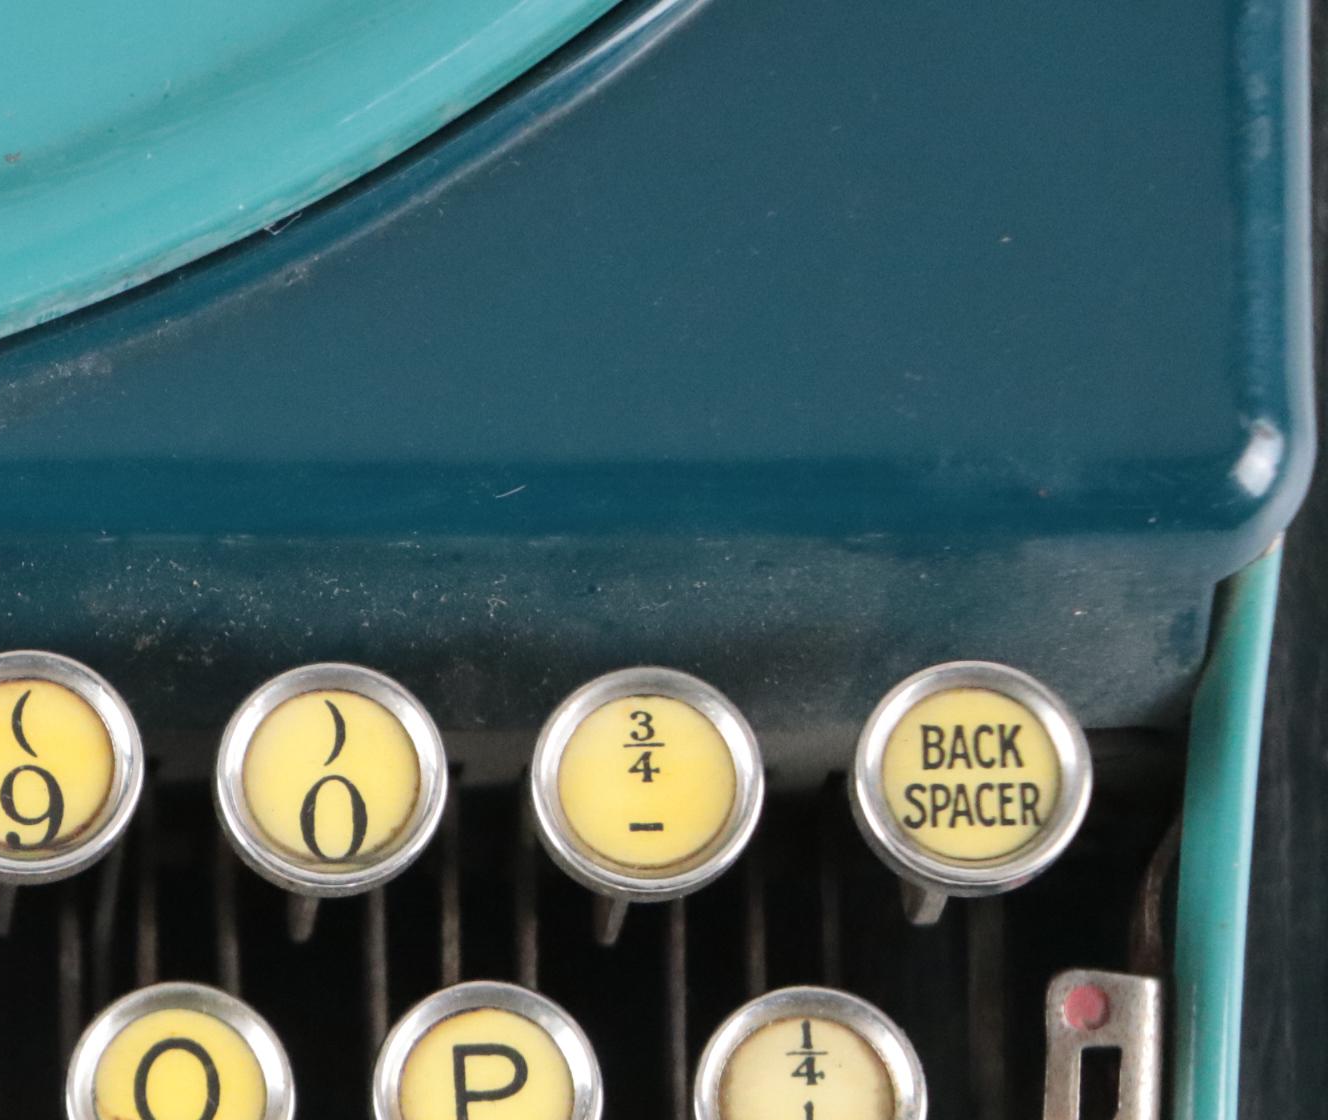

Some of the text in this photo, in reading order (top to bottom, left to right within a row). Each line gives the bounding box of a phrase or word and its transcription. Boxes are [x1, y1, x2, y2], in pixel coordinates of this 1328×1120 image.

[11, 689, 38, 758] (
[324, 699, 346, 766] )
[921, 724, 1024, 770] BACK
[0, 764, 65, 851] 9
[902, 782, 1041, 830] SPACER
